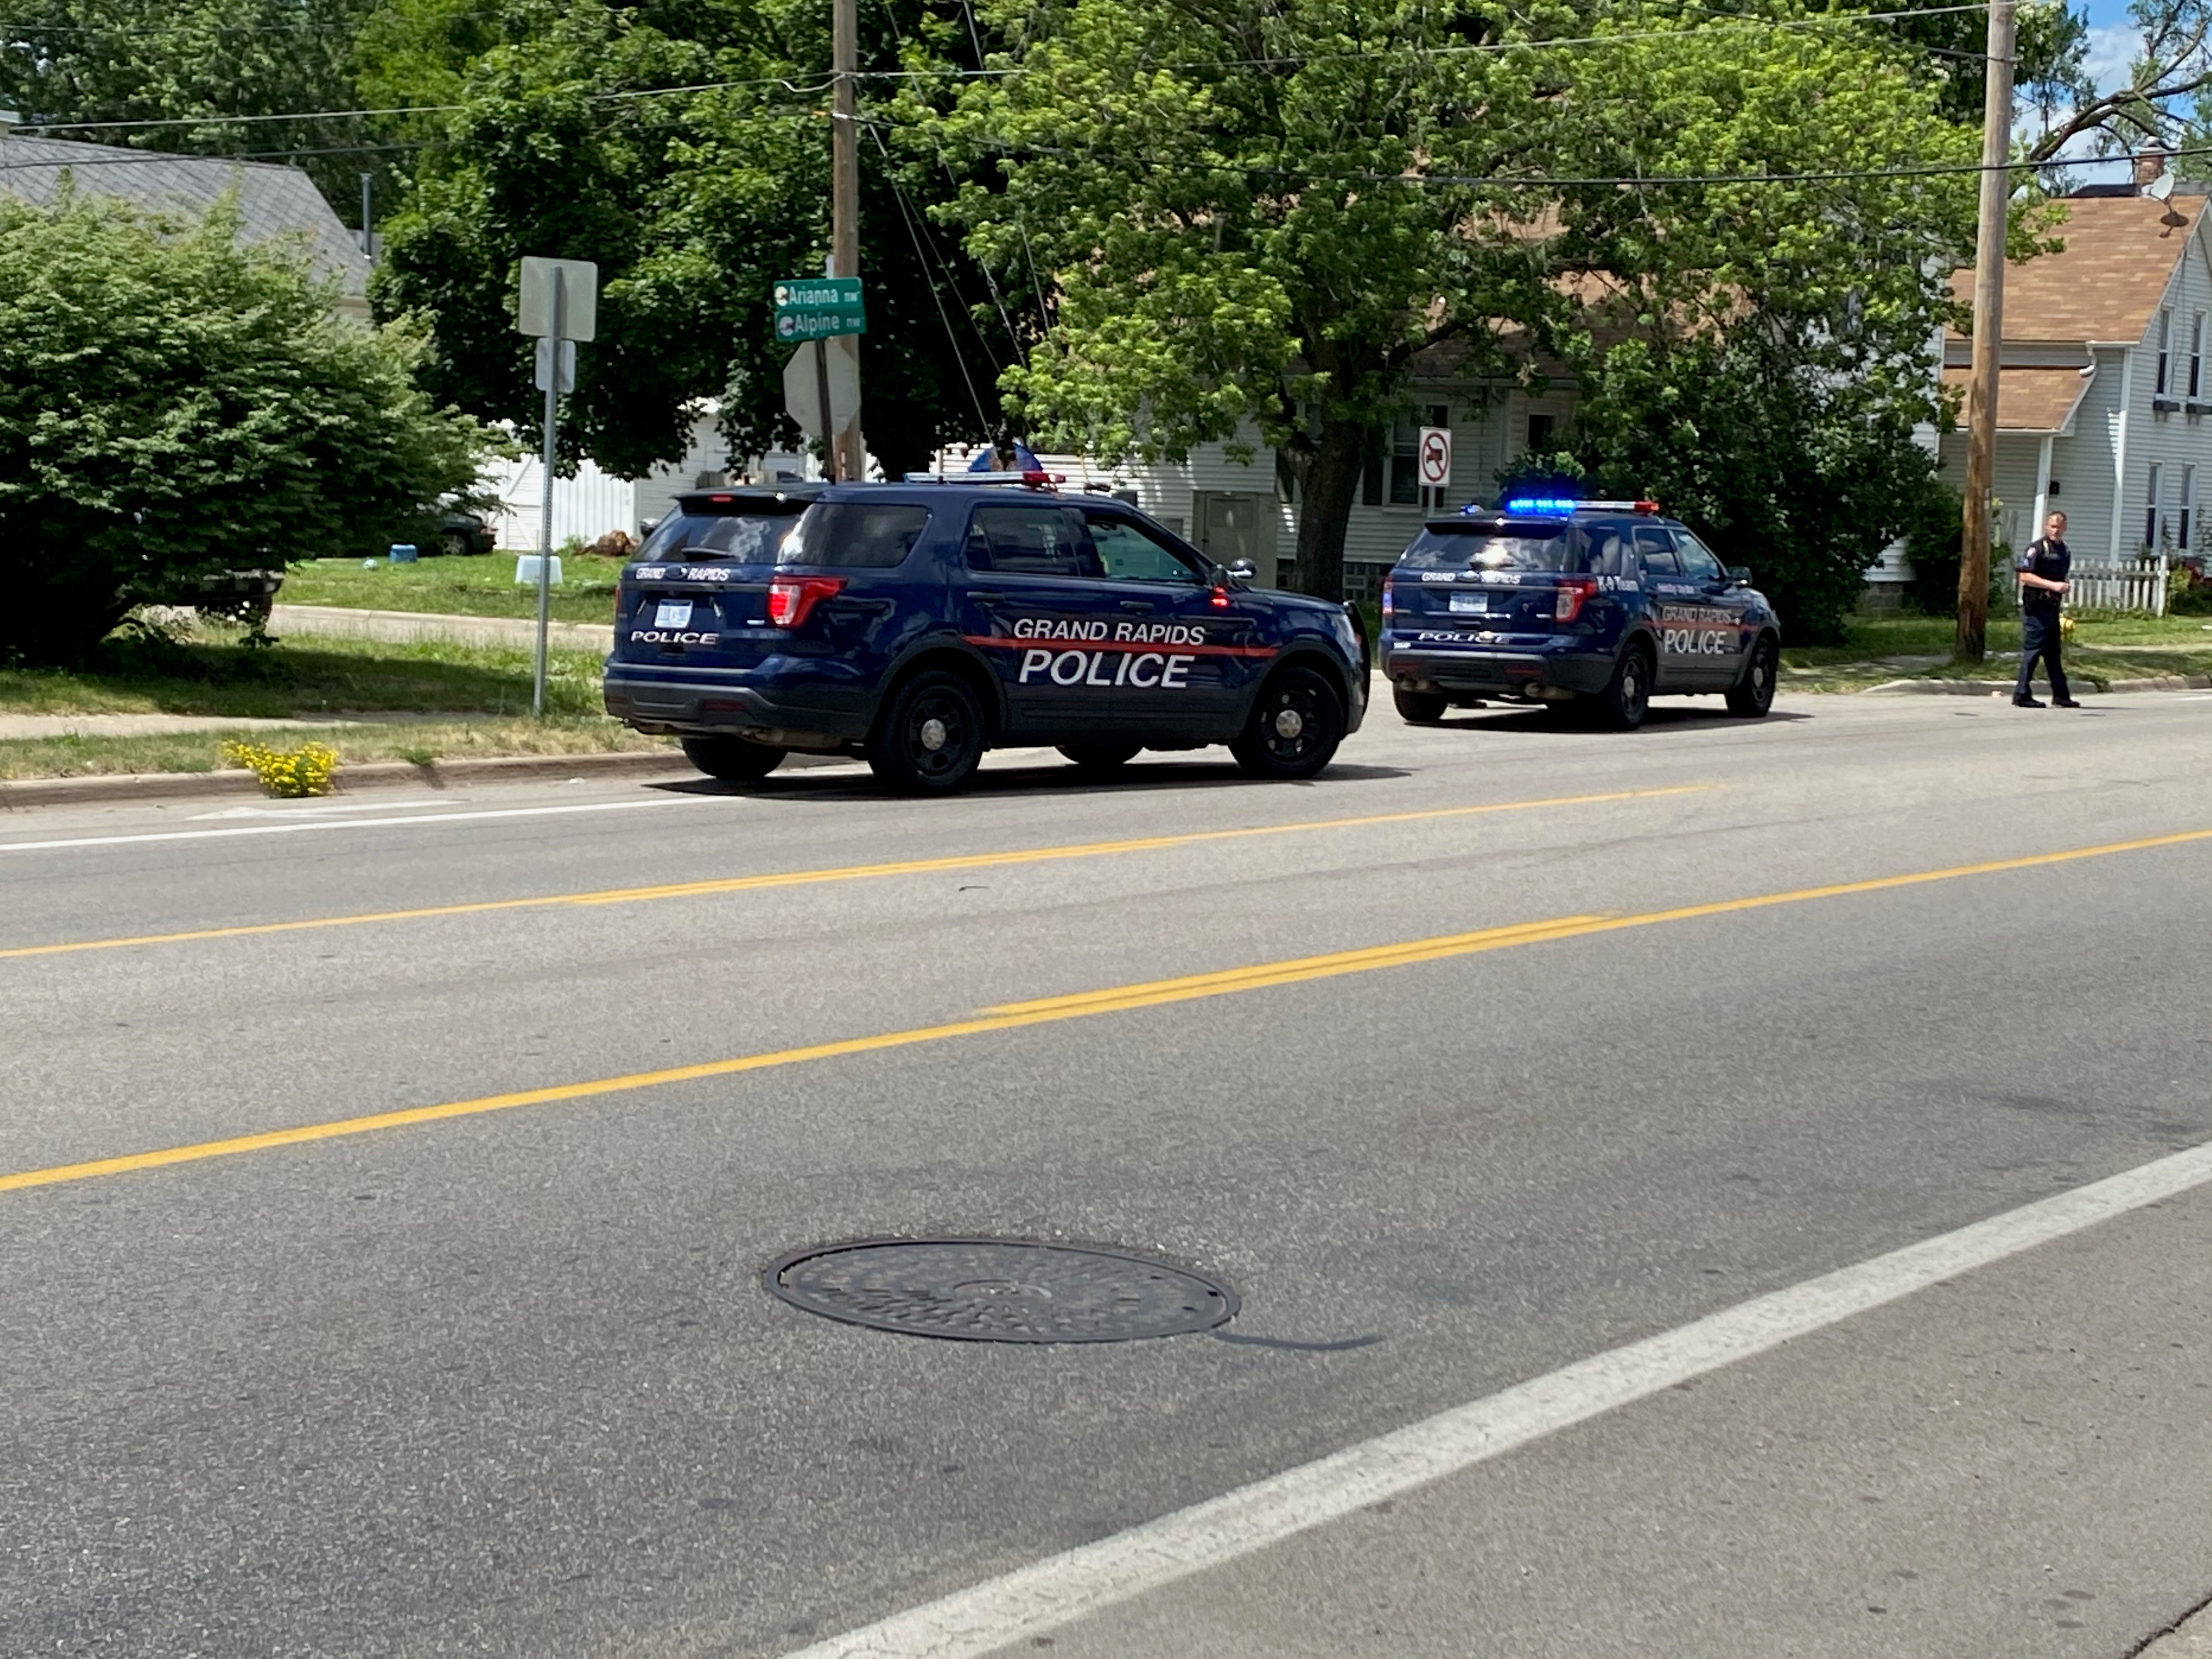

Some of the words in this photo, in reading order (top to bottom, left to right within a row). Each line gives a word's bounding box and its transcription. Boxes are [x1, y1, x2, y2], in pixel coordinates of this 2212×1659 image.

[789, 286, 838, 304] Arianna
[795, 312, 840, 336] Alpine
[635, 567, 666, 580] GRAND
[687, 567, 731, 582] RAPIDS
[1480, 571, 1522, 584] PIDS
[1662, 605, 1697, 622] GRAND
[1699, 607, 1732, 624] RAPIDS
[631, 630, 720, 645] POLICE
[1014, 618, 1108, 641] GRAND
[1114, 622, 1206, 646] RAPIDS
[1663, 629, 1728, 654] POLICE
[1018, 648, 1195, 688] POLICE
